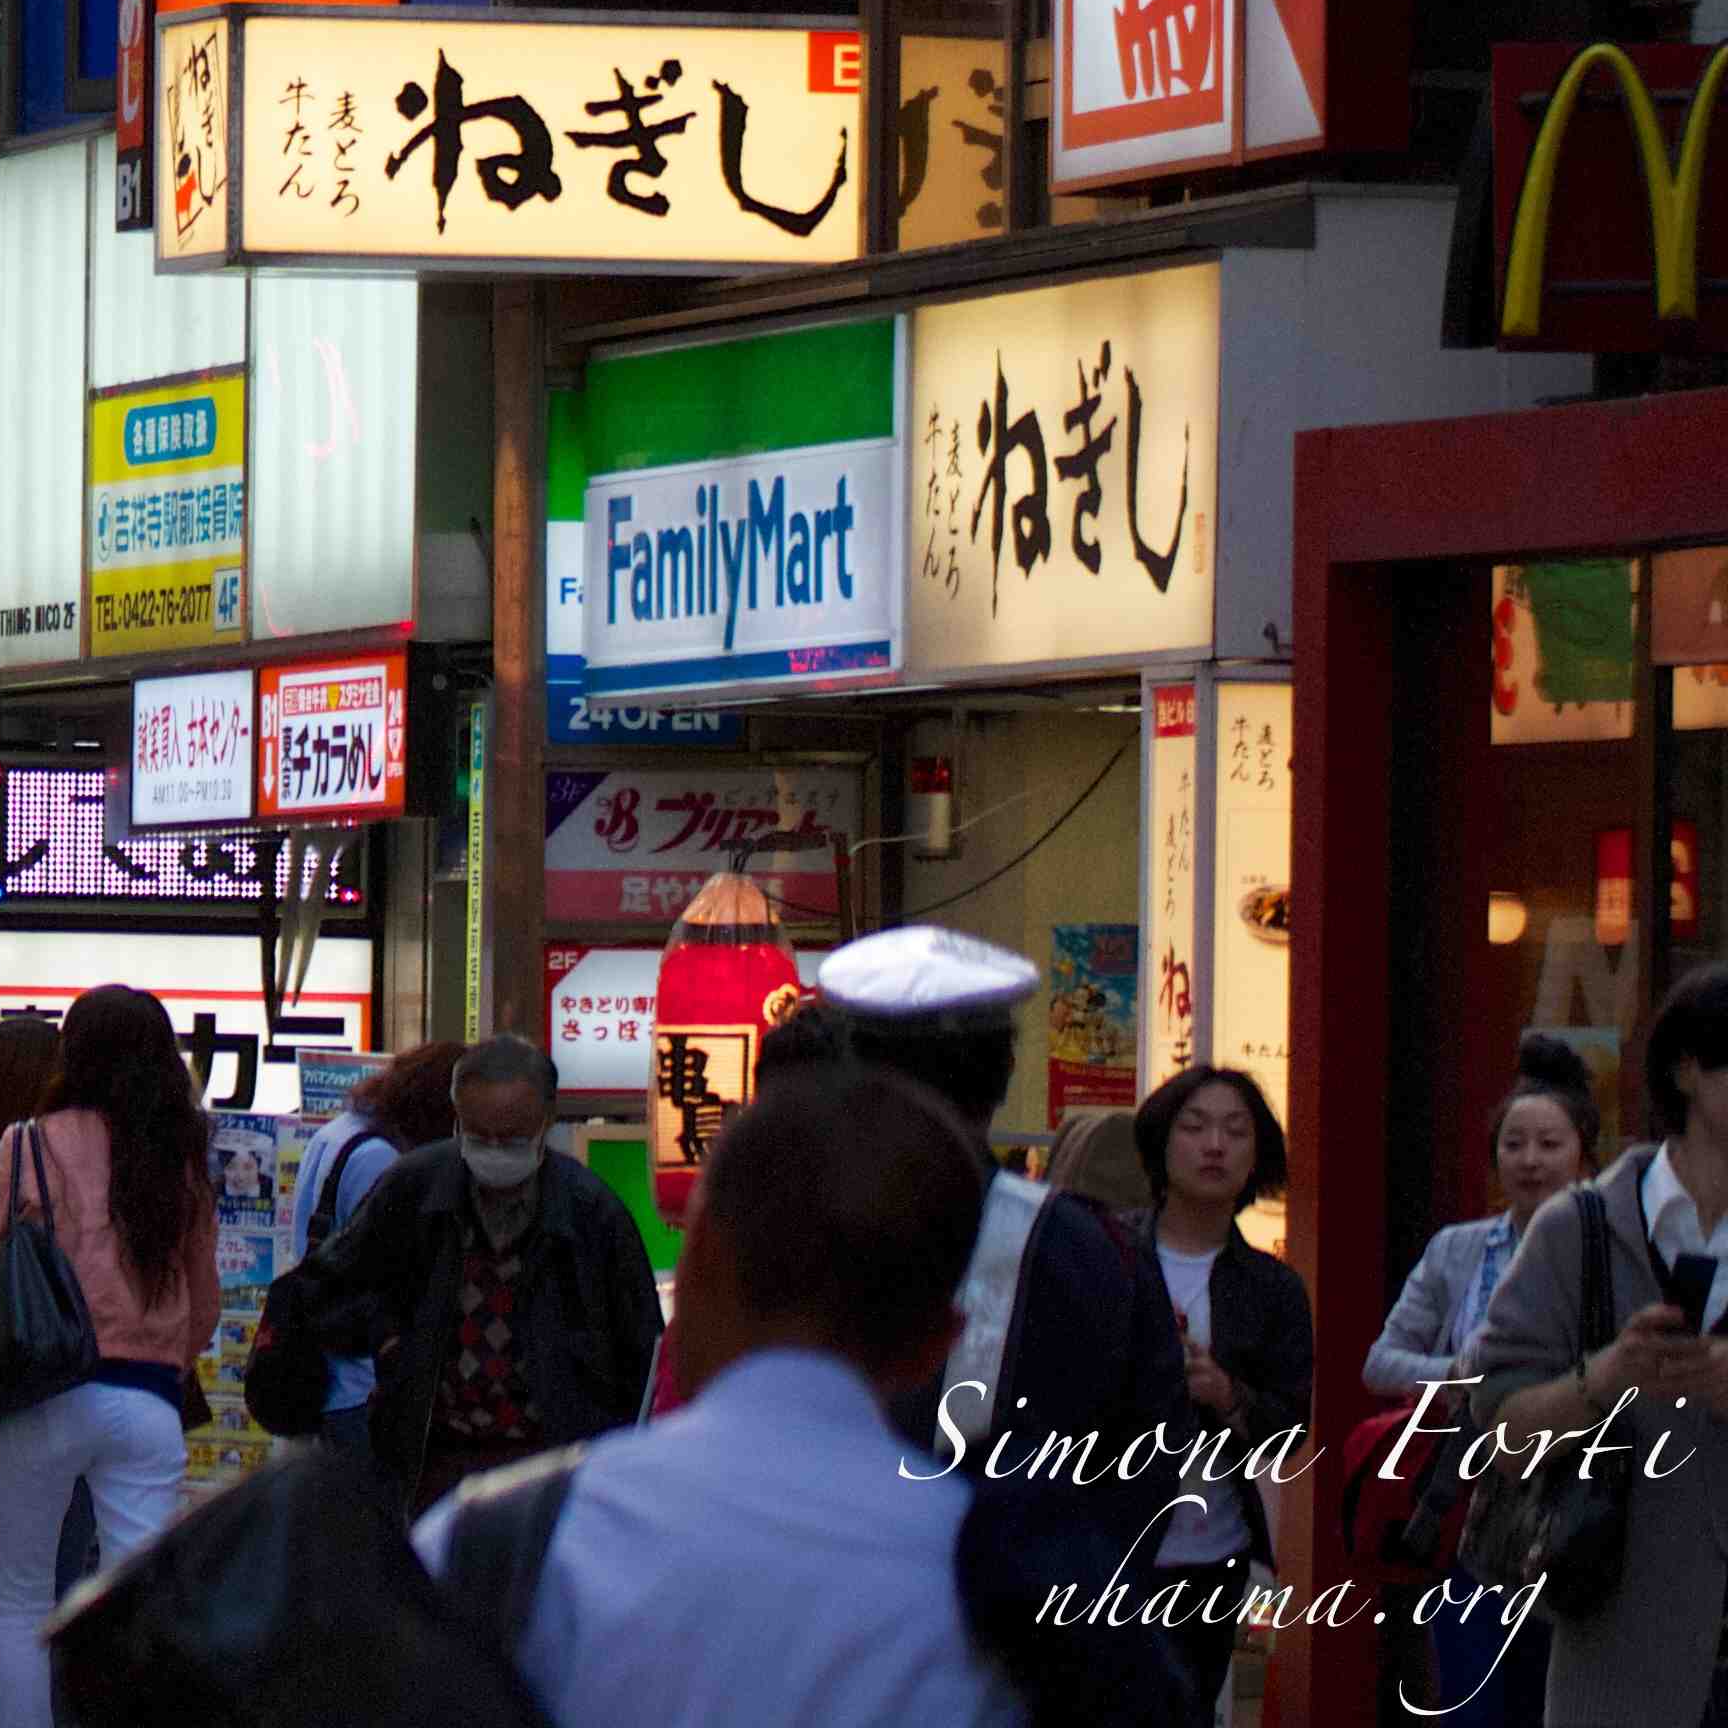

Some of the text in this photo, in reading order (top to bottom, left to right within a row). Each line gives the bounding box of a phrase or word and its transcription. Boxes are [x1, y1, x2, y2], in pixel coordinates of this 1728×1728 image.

[277, 77, 316, 200] 牛たん
[327, 90, 362, 217] 麦とろ
[384, 48, 848, 238] ねぎし
[113, 478, 244, 554] 吉祥寺駅前接骨院
[969, 338, 1191, 619] ねぎし
[218, 574, 240, 624] 4F
[606, 474, 855, 651] FamilyMart
[34, 604, 61, 636] NICO
[62, 600, 78, 631] 2F
[186, 696, 250, 772] 古本センター
[292, 720, 383, 802] チカラめし
